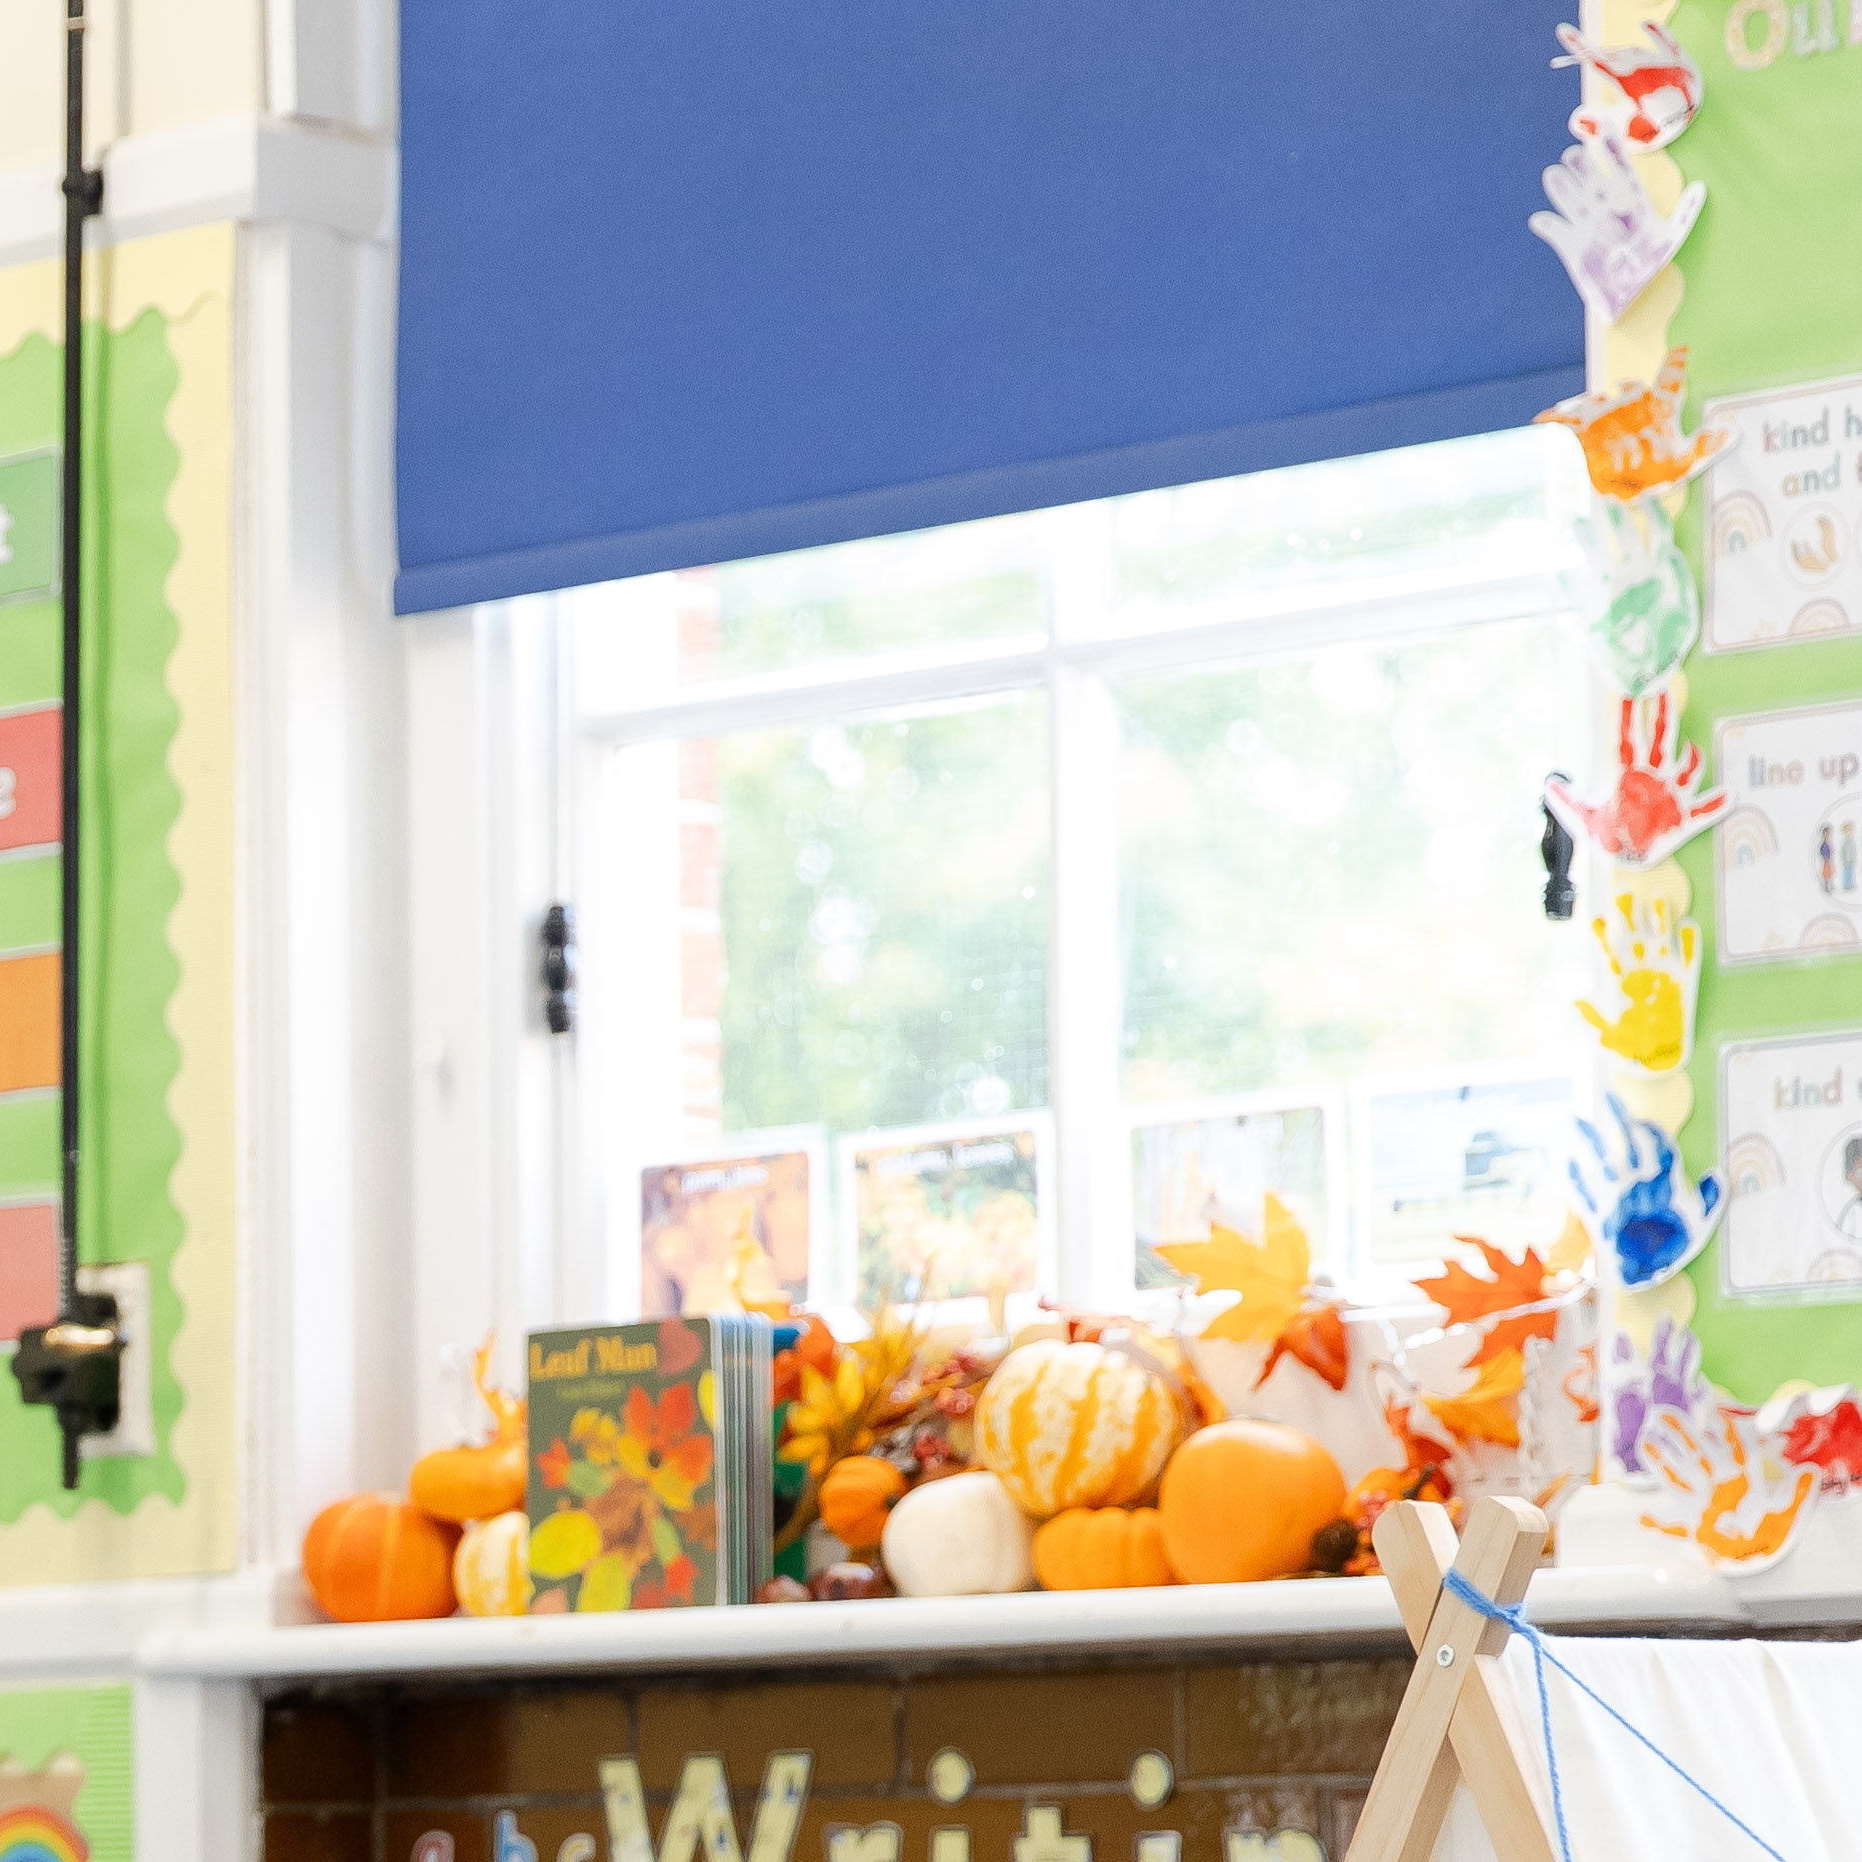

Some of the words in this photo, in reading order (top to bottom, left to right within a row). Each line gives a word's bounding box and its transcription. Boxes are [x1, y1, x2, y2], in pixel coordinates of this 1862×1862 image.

[1763, 406, 1829, 453] kind
[1782, 452, 1841, 499] and
[1747, 754, 1805, 788] line
[1819, 753, 1859, 787] up
[1774, 1066, 1843, 1110] kind
[528, 1338, 592, 1381] Leaf
[596, 1335, 658, 1373] Man
